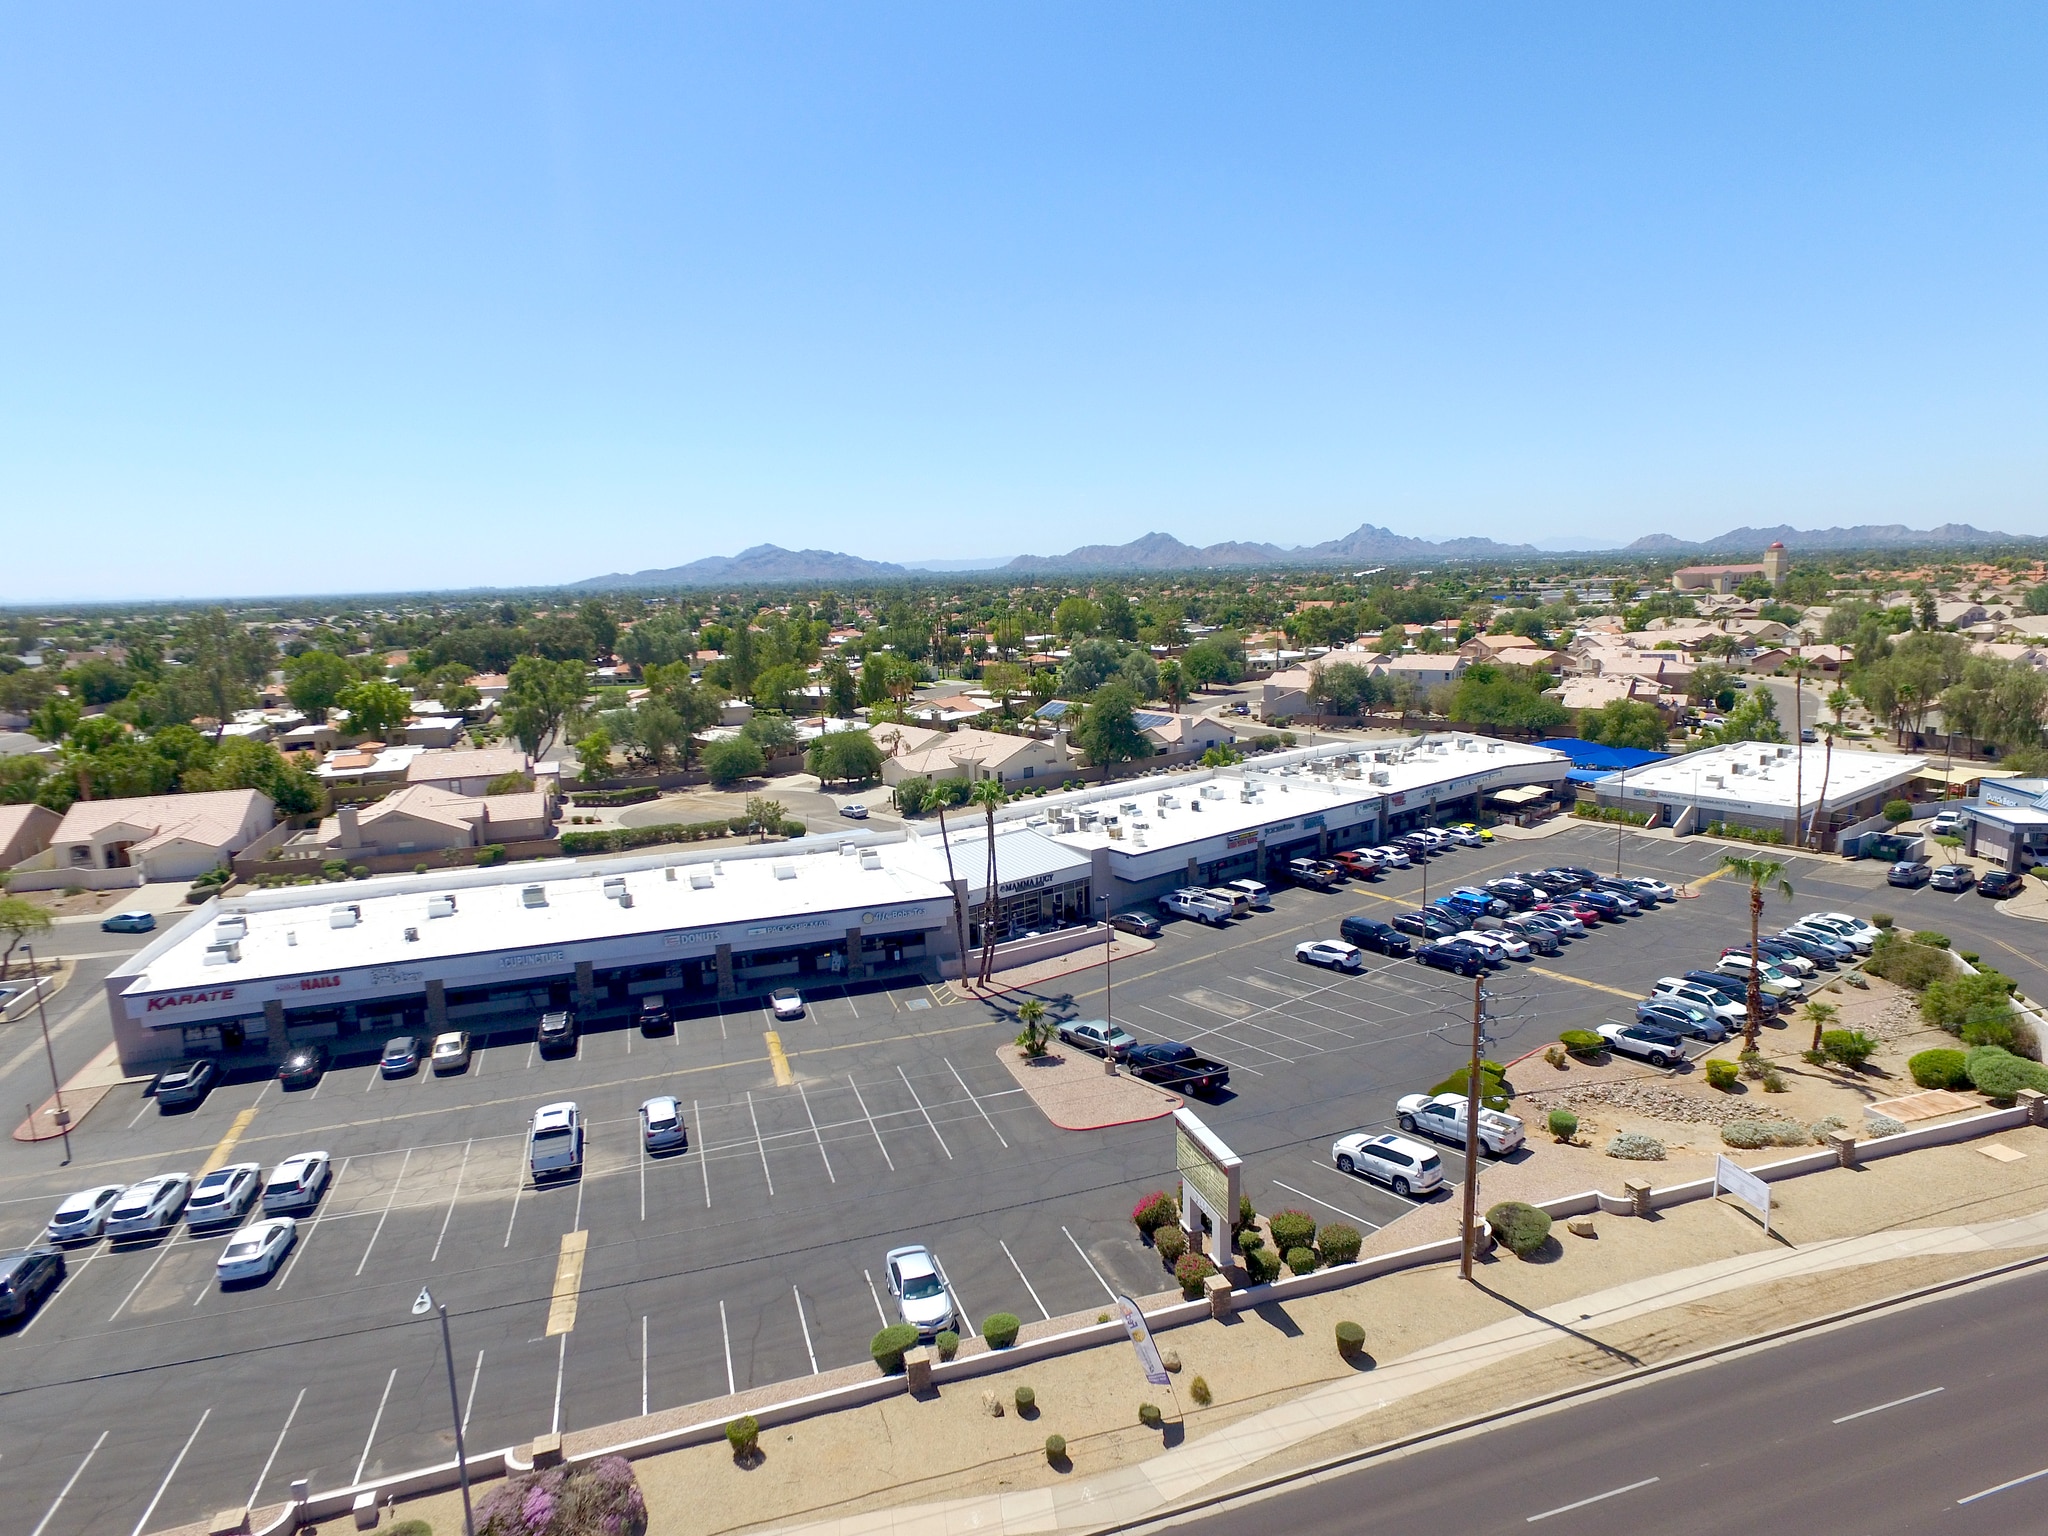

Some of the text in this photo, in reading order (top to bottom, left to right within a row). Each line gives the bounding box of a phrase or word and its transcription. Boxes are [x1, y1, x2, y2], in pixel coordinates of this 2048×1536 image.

[1005, 873, 1054, 892] MAMMA LUCY
[892, 910, 911, 919] Boba
[680, 930, 721, 945] DONUTS
[499, 951, 564, 969] ACUPUNCTURE
[300, 976, 341, 991] NAILS
[147, 988, 234, 1011] KARATE
